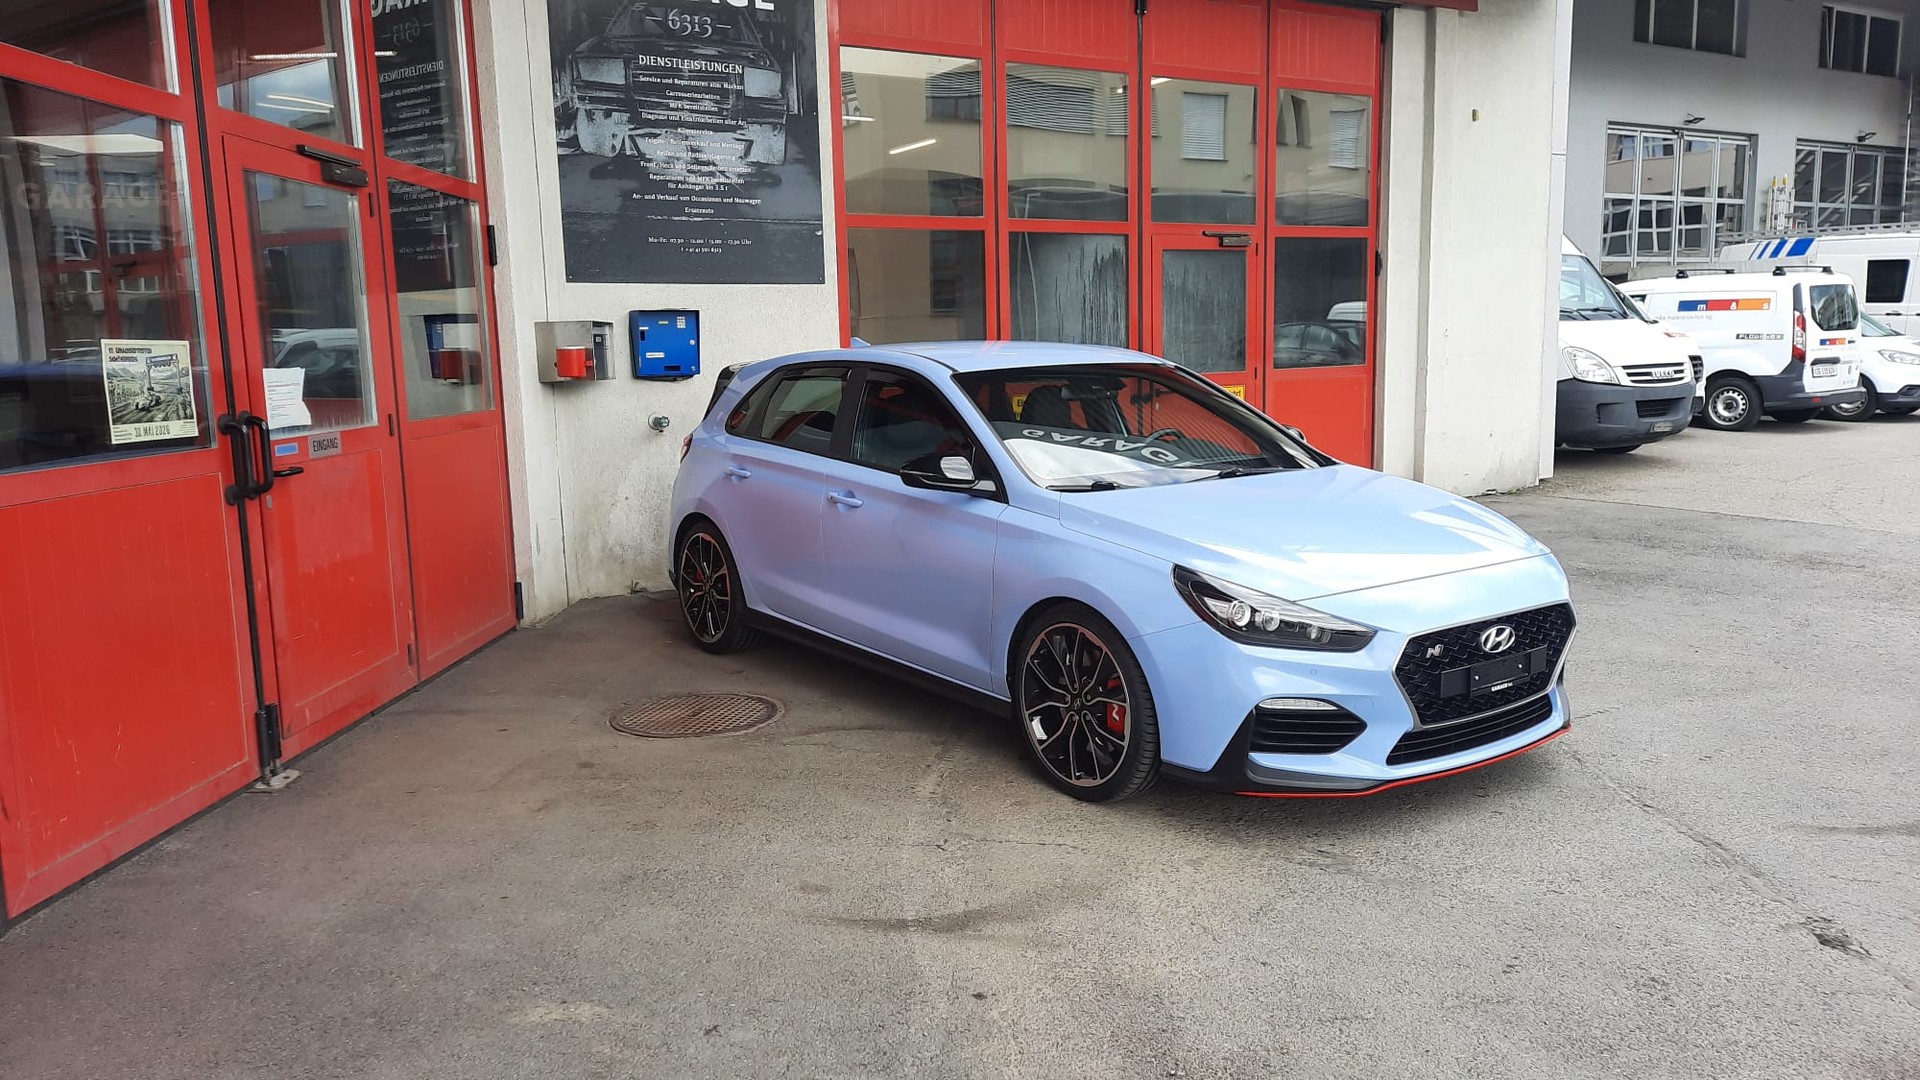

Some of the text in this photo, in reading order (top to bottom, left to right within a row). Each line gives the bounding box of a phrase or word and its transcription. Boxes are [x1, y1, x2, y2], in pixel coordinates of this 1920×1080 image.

[668, 8, 712, 38] 6313
[638, 54, 742, 74] DIENSTLEISTUNGEN
[640, 75, 660, 83] Service
[642, 112, 667, 121] Diagnose
[678, 183, 704, 191] Anhänger
[313, 438, 338, 452] EINGANG
